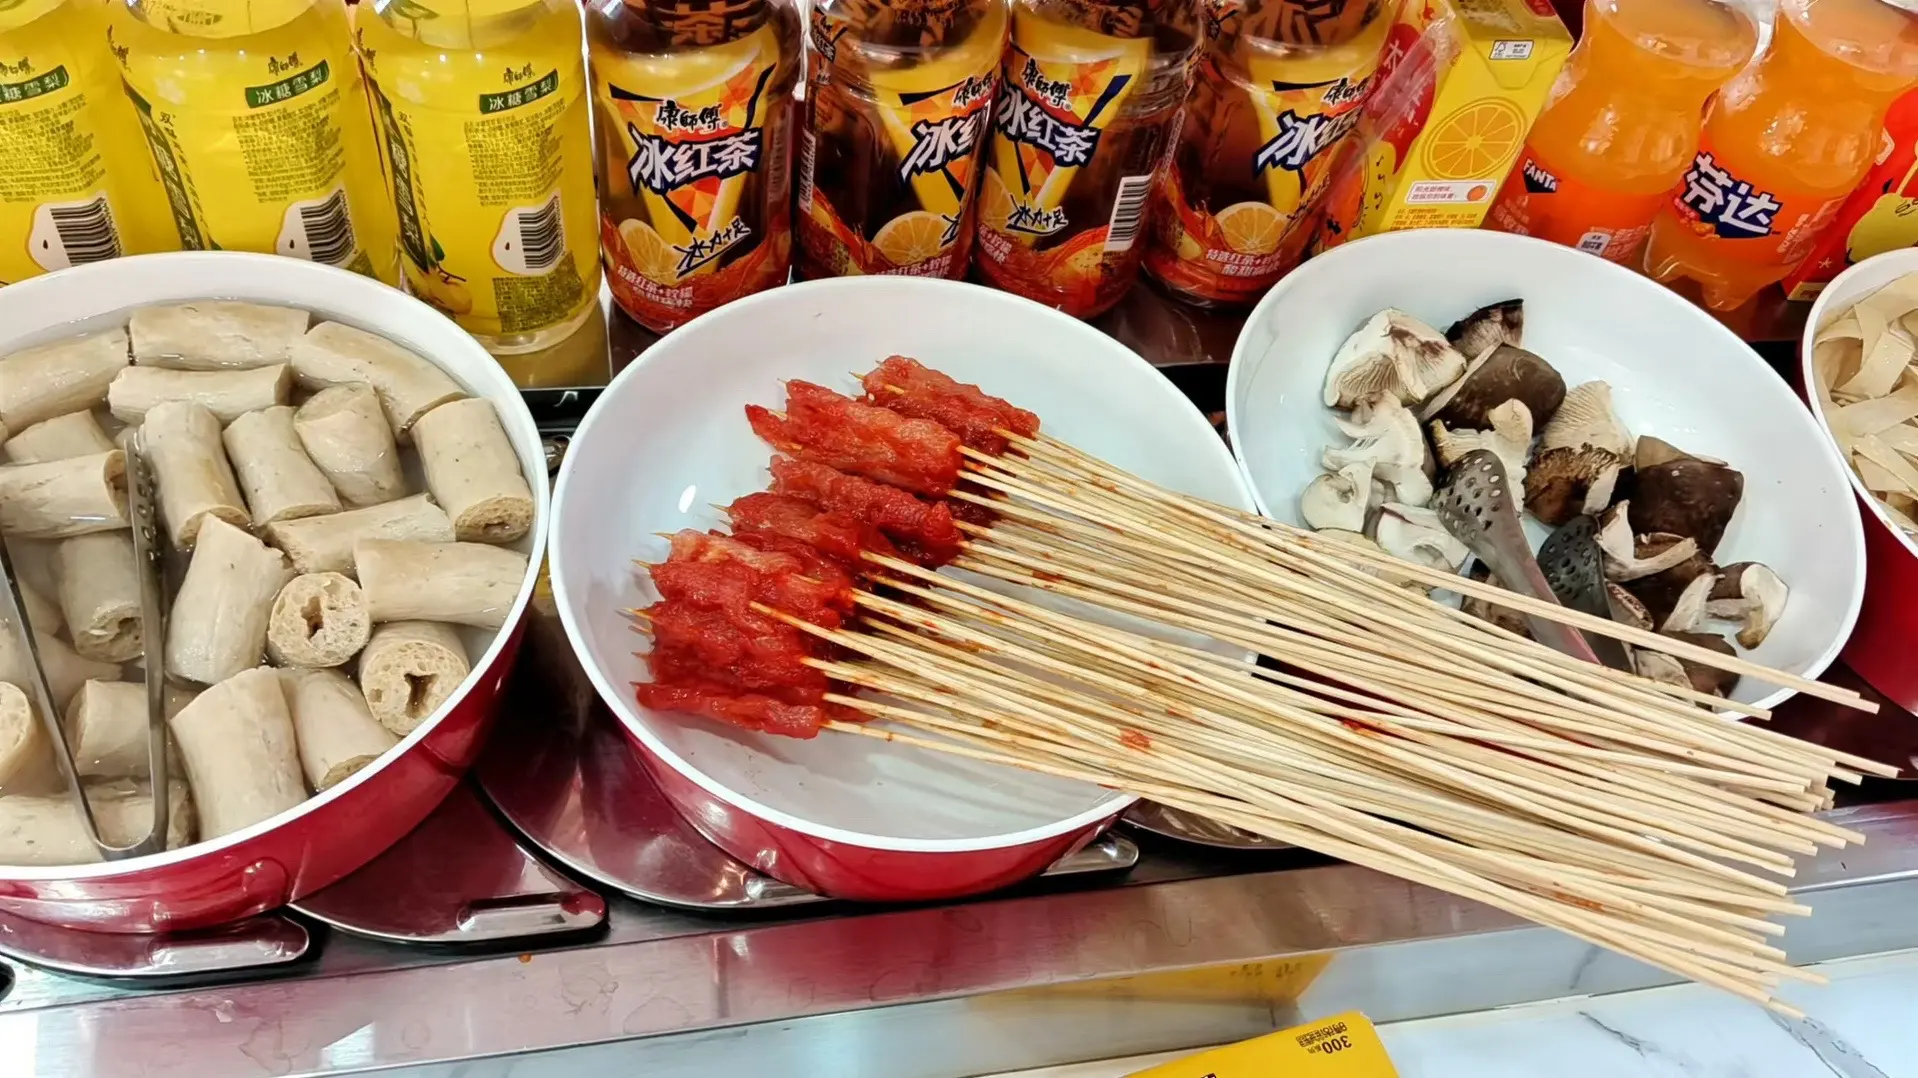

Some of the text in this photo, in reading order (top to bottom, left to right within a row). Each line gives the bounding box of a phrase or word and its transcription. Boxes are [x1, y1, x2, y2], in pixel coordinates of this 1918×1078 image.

[256, 67, 324, 104] 冰糖雪梨
[489, 76, 553, 111] 冰糖雪梨
[994, 80, 1098, 163] 冰红茶
[630, 131, 760, 188] 冰红茶
[1522, 157, 1557, 192] FANTA
[1684, 153, 1780, 234] 芬达
[1324, 1034, 1352, 1055] 300
